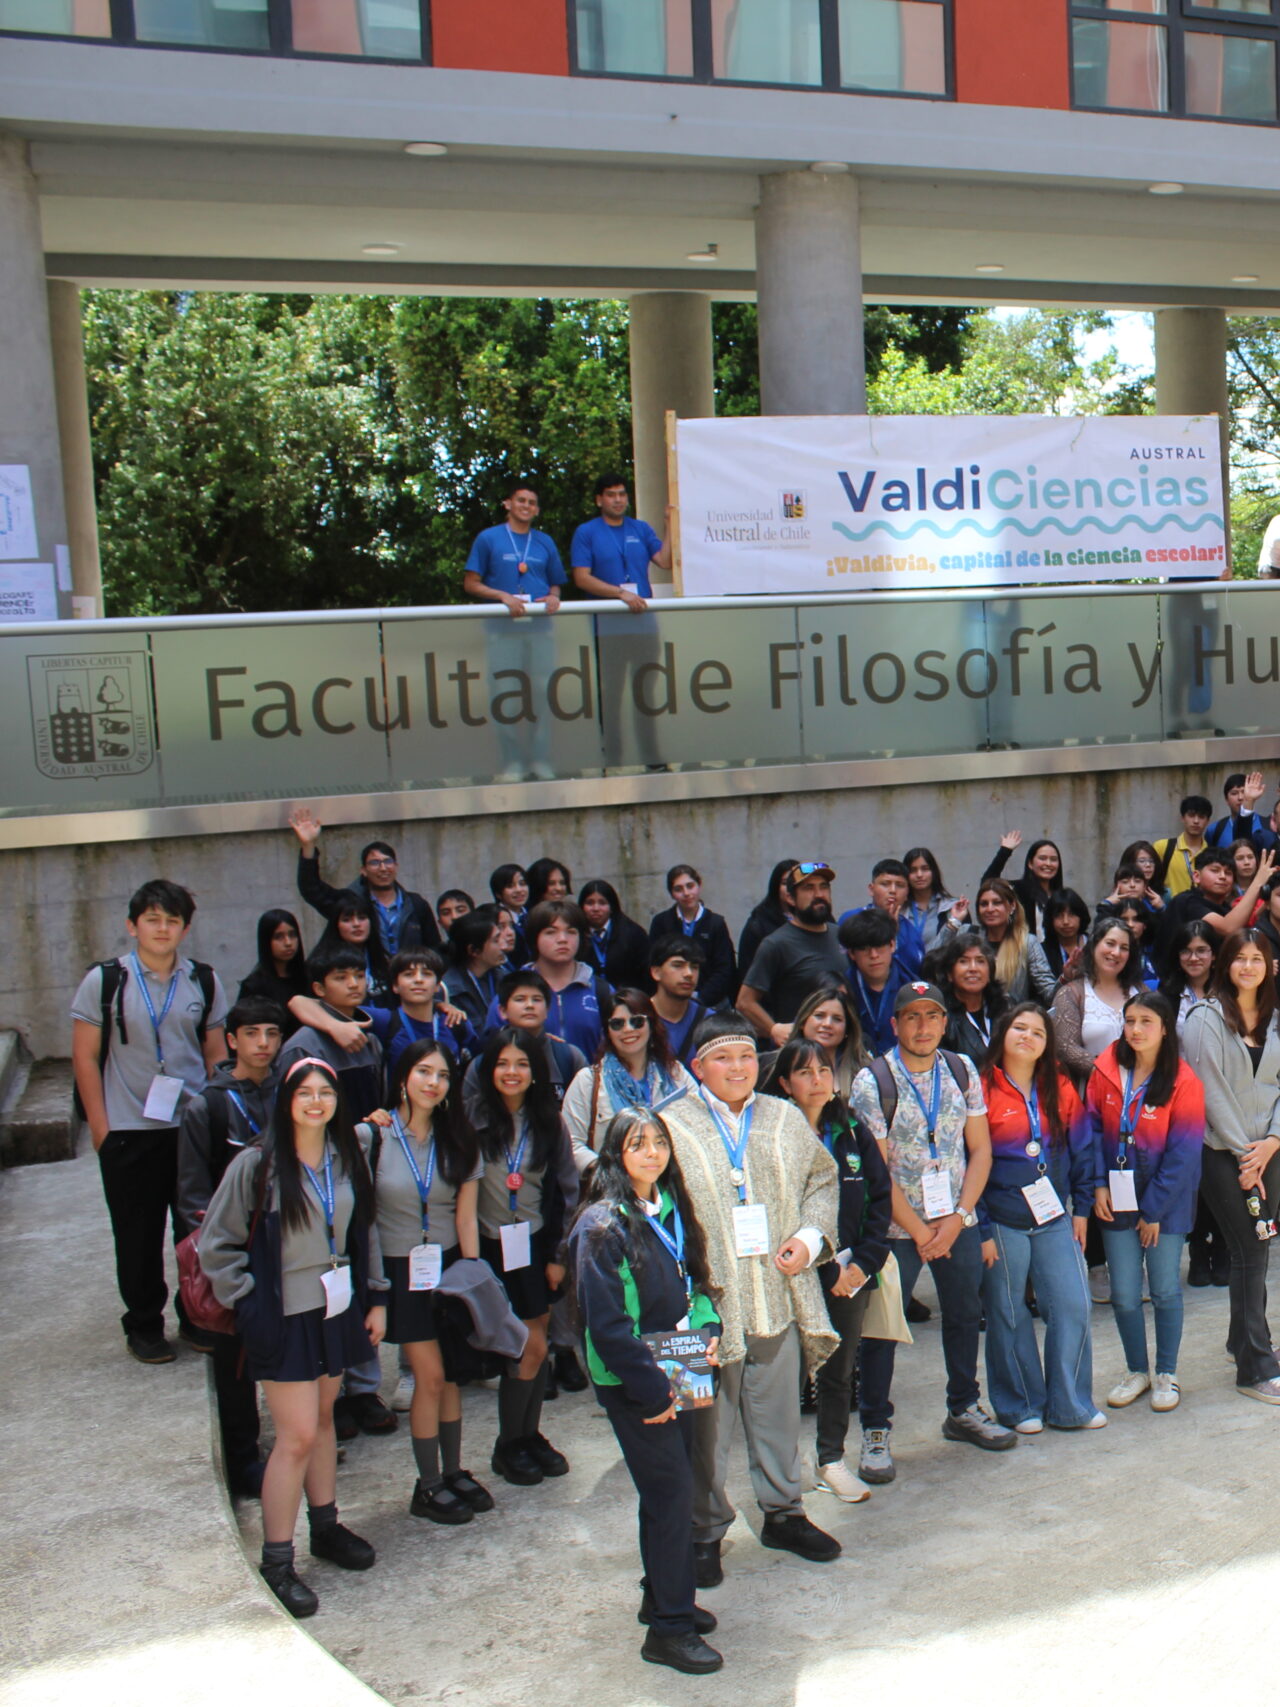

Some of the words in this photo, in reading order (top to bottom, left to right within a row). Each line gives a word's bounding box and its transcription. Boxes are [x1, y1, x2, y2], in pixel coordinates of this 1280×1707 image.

[1130, 447, 1206, 460] AUSTRAL
[837, 464, 1209, 512] ValdiCiencias
[706, 508, 774, 522] Universidad
[704, 522, 760, 543] Austral
[763, 527, 777, 541] de
[780, 526, 811, 541] Chile
[826, 554, 936, 577] ¡Valdivia,
[939, 551, 1012, 572] capital
[1016, 550, 1041, 567] de
[1044, 550, 1063, 566] la
[1066, 547, 1142, 565] ciencia
[1145, 545, 1224, 562] escolar!
[41, 659, 87, 668] LIBERTAS
[90, 656, 132, 665] CAPITUR
[205, 645, 593, 741] Facultad
[631, 641, 733, 717] de
[769, 622, 1102, 709] Filosofía
[1126, 641, 1165, 708] y
[83, 763, 132, 774] AUSTRAL
[671, 1335, 701, 1345] ESPIRAL
[671, 1344, 706, 1355] TIEMPO
